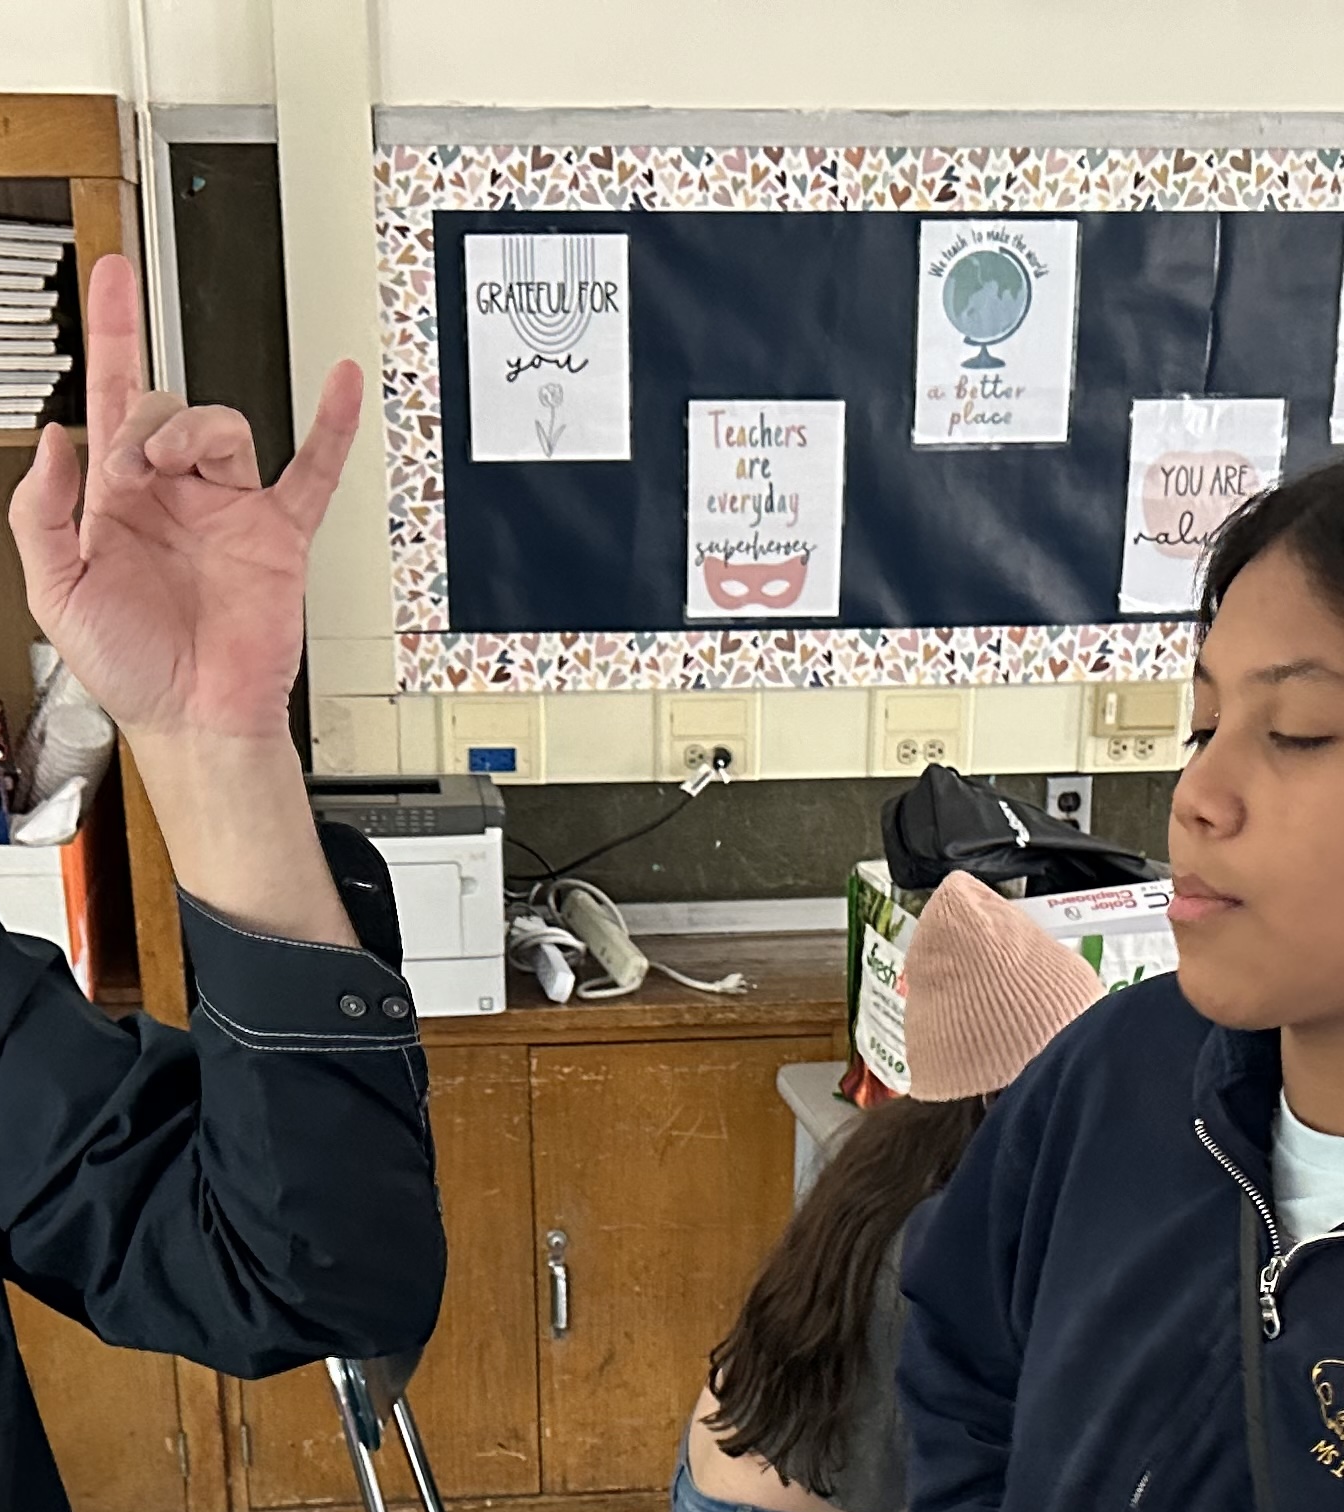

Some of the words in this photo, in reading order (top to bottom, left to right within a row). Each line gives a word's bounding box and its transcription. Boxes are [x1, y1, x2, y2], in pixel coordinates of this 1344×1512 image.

[927, 260, 947, 278] We
[971, 229, 984, 244] to
[477, 282, 570, 315] GRATEFUL
[578, 281, 619, 314] FOR
[507, 353, 589, 382] you
[956, 374, 1026, 400] better
[708, 410, 807, 448] Teachers
[948, 401, 1013, 436] place
[736, 457, 772, 480] are
[1161, 465, 1204, 496] YOU
[1209, 464, 1248, 496] ARE
[707, 481, 799, 528] everyday
[695, 530, 818, 568] superheroes
[1310, 1440, 1340, 1465] MS
